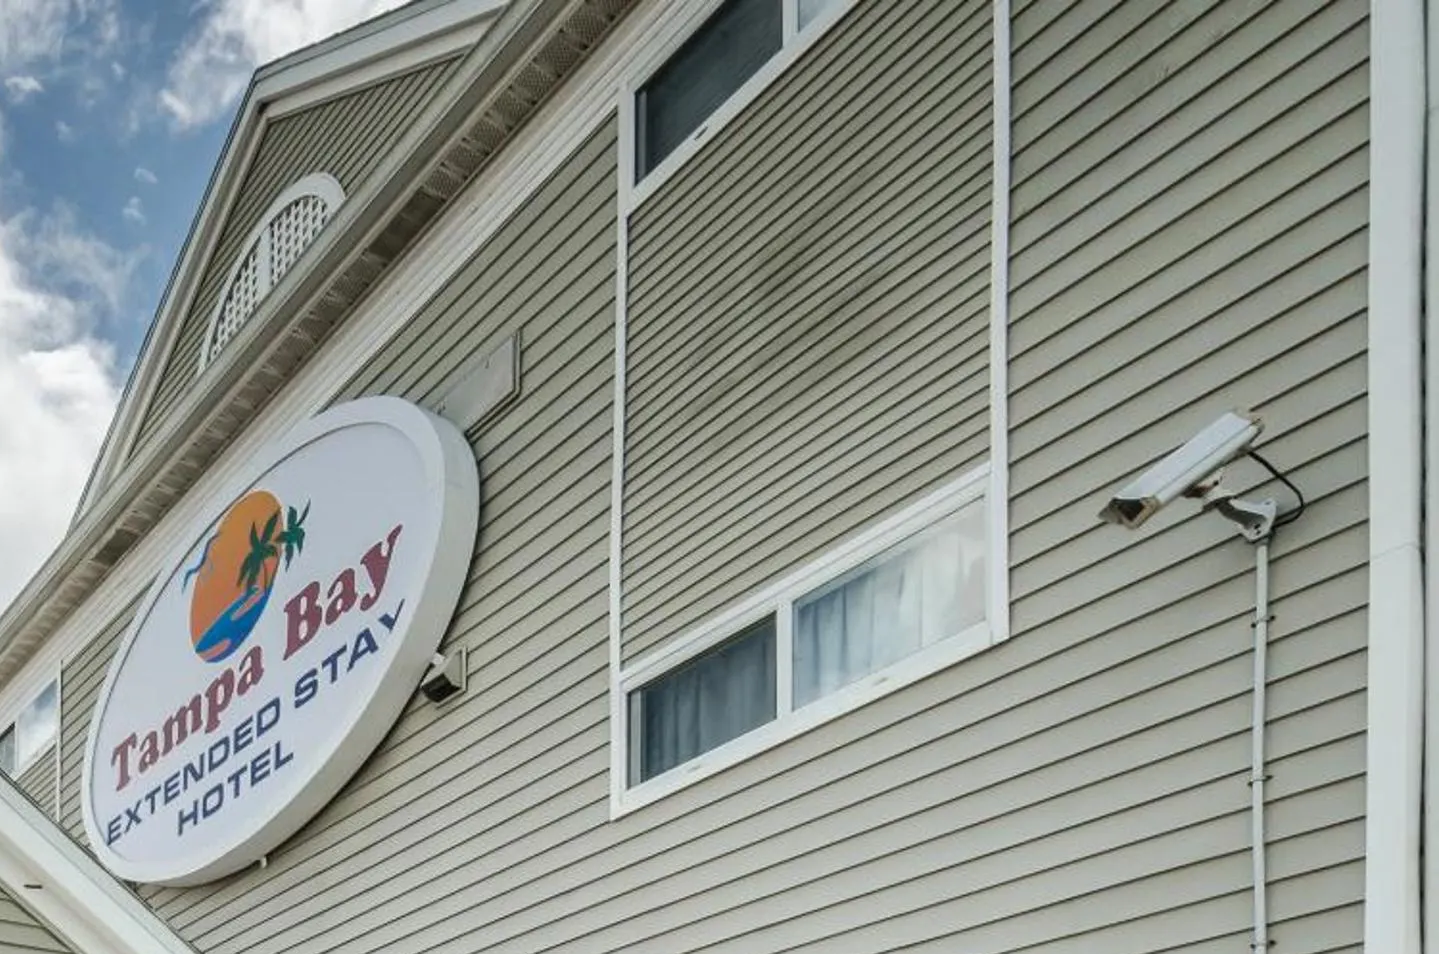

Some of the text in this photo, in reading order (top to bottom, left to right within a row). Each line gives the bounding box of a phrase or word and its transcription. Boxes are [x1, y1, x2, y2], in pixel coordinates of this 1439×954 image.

[107, 598, 406, 846] EXTENDED STAY
[111, 524, 403, 792] Tampa Bay
[177, 740, 294, 836] HOTEL
